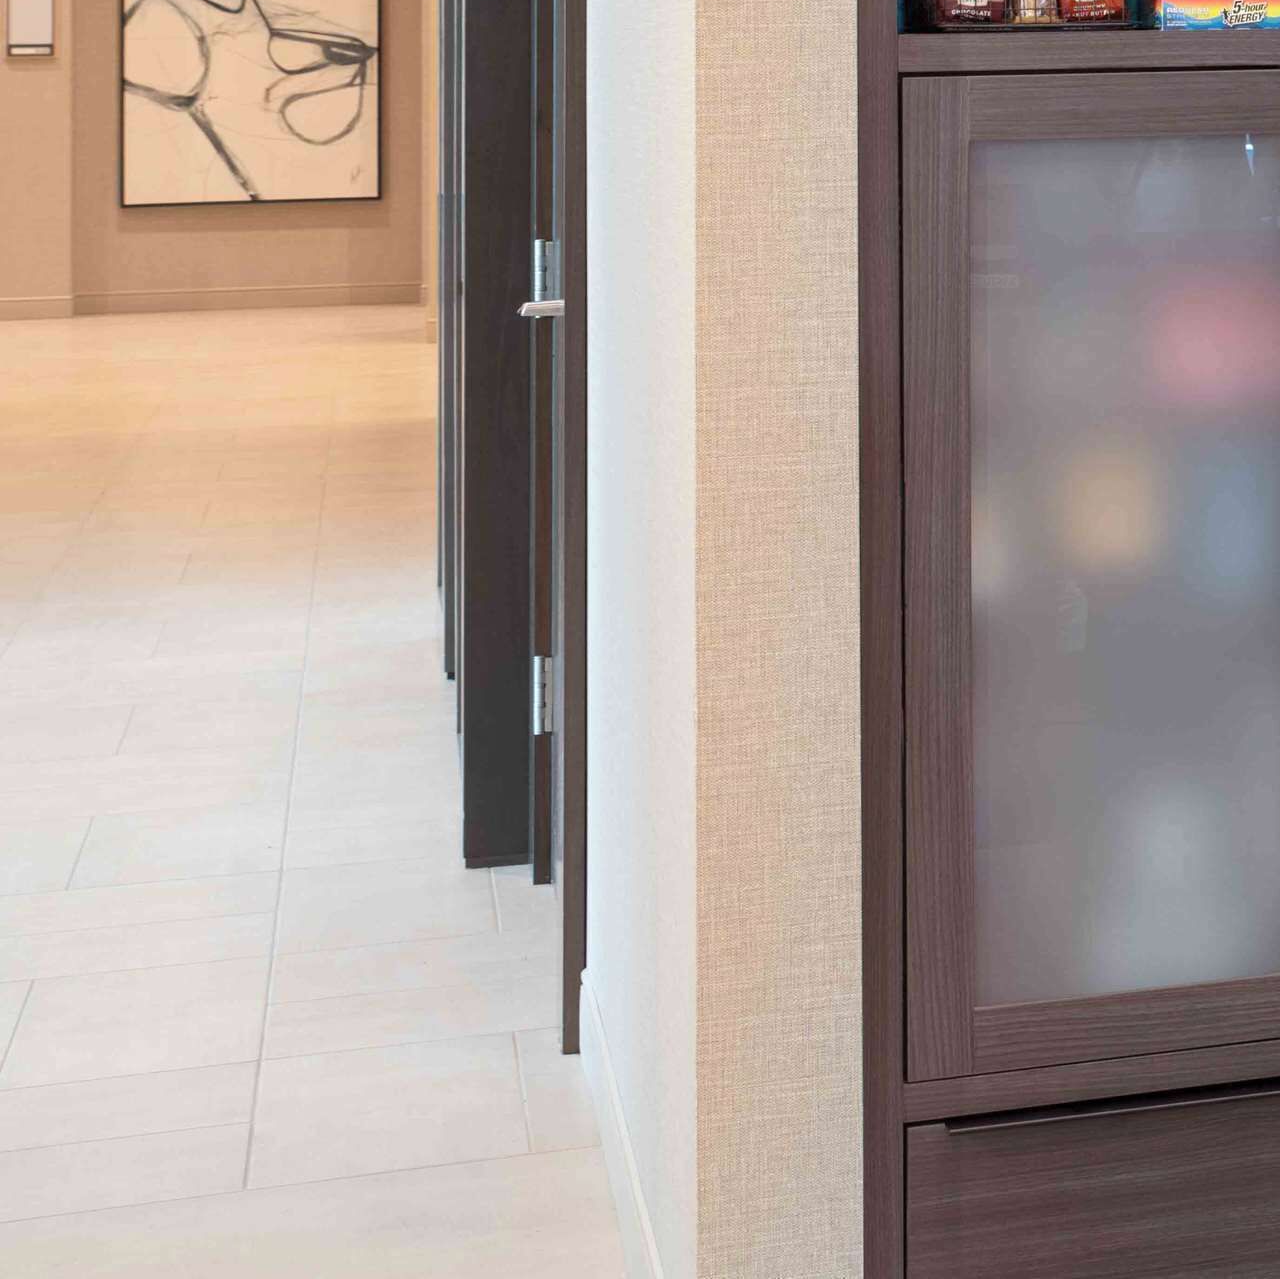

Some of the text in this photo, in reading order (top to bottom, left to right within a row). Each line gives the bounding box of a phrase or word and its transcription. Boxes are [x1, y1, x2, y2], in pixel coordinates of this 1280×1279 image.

[1233, 0, 1267, 13] 5-hour
[951, 8, 992, 18] CHOCOLATE
[1229, 12, 1265, 24] ENERGY
